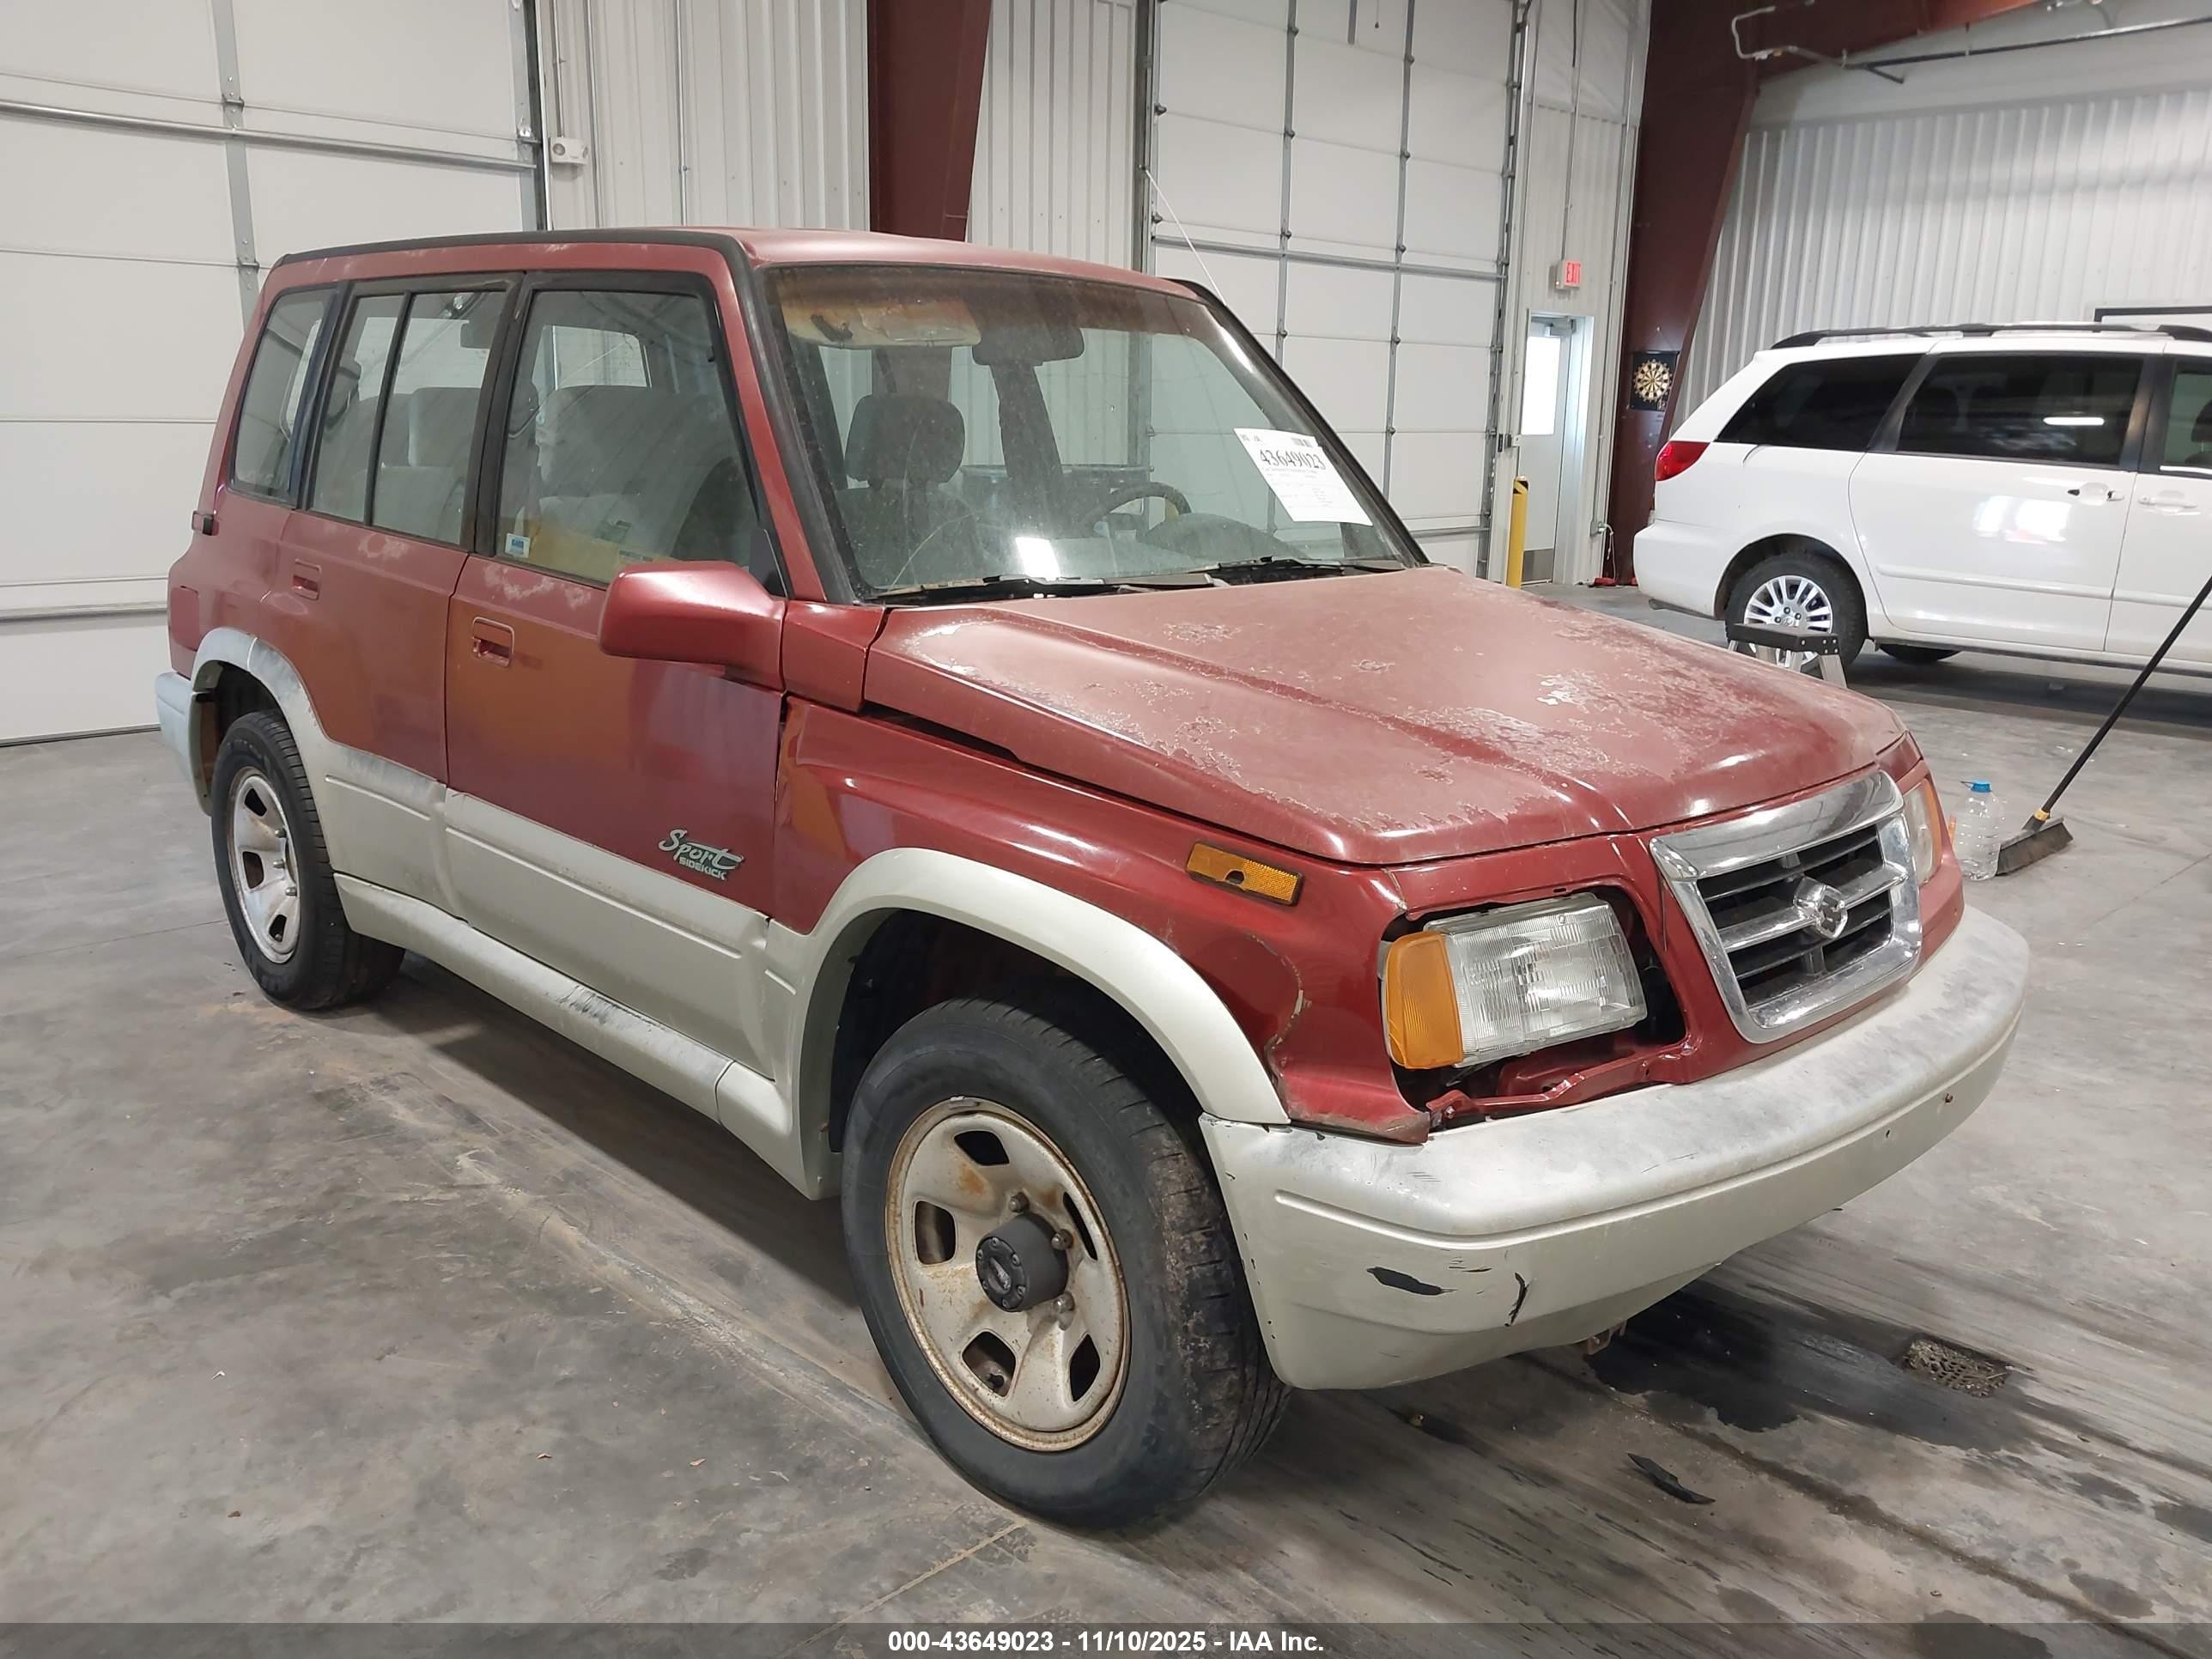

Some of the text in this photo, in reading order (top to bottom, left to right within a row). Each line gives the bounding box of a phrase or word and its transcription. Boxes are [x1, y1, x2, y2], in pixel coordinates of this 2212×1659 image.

[1260, 449, 1326, 470] 43649023
[659, 829, 744, 869] Sport
[679, 857, 727, 881] SIDEKICK
